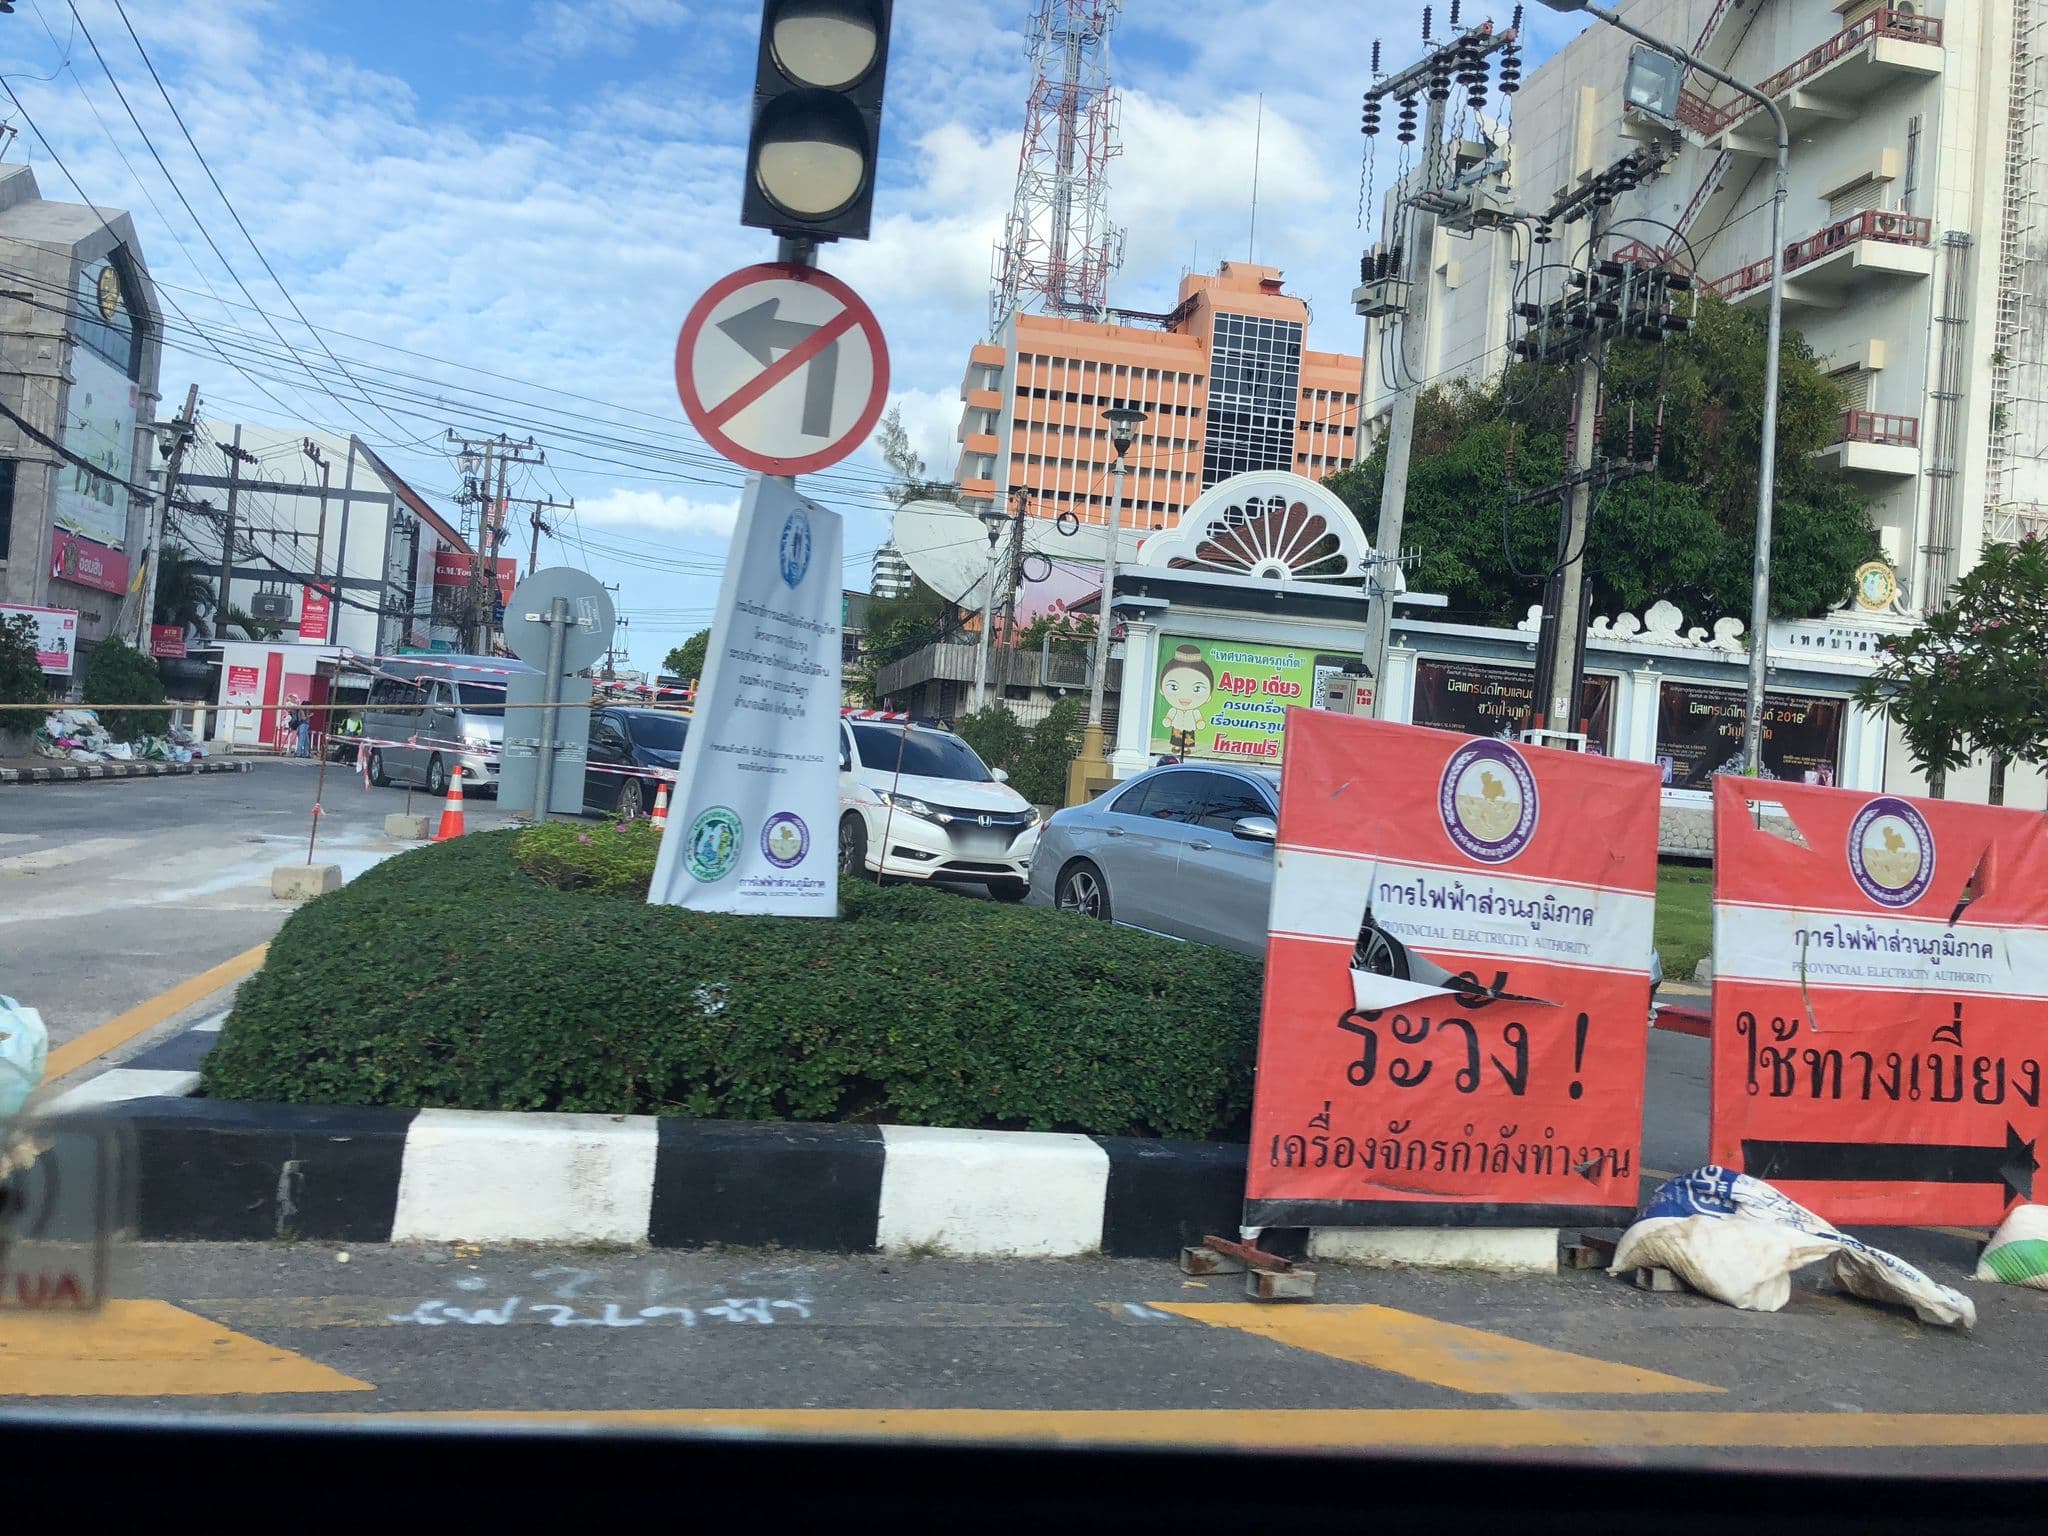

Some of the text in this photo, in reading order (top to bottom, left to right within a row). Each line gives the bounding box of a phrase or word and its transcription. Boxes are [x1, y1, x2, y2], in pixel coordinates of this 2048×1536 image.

[1218, 671, 1302, 698] App เดียว
[1478, 700, 1531, 721] ขวัญใจภูเก็
[1379, 878, 1594, 930] การไฟฟ้าส่วนภูมิภาค
[1379, 919, 1592, 955] PROVINCIAL ELECTRICITY AUTHORITY
[1795, 924, 1993, 965] การไฟฟ้าส่วนภูมิภาค
[1792, 961, 1993, 985] PROVINCIAL ELECTRICITY AUTHORITY
[1736, 1002, 2041, 1107] ใช้ทางเบี่ยง
[1270, 1101, 1631, 1179] เครื่องจักรกำลังทำงาน
